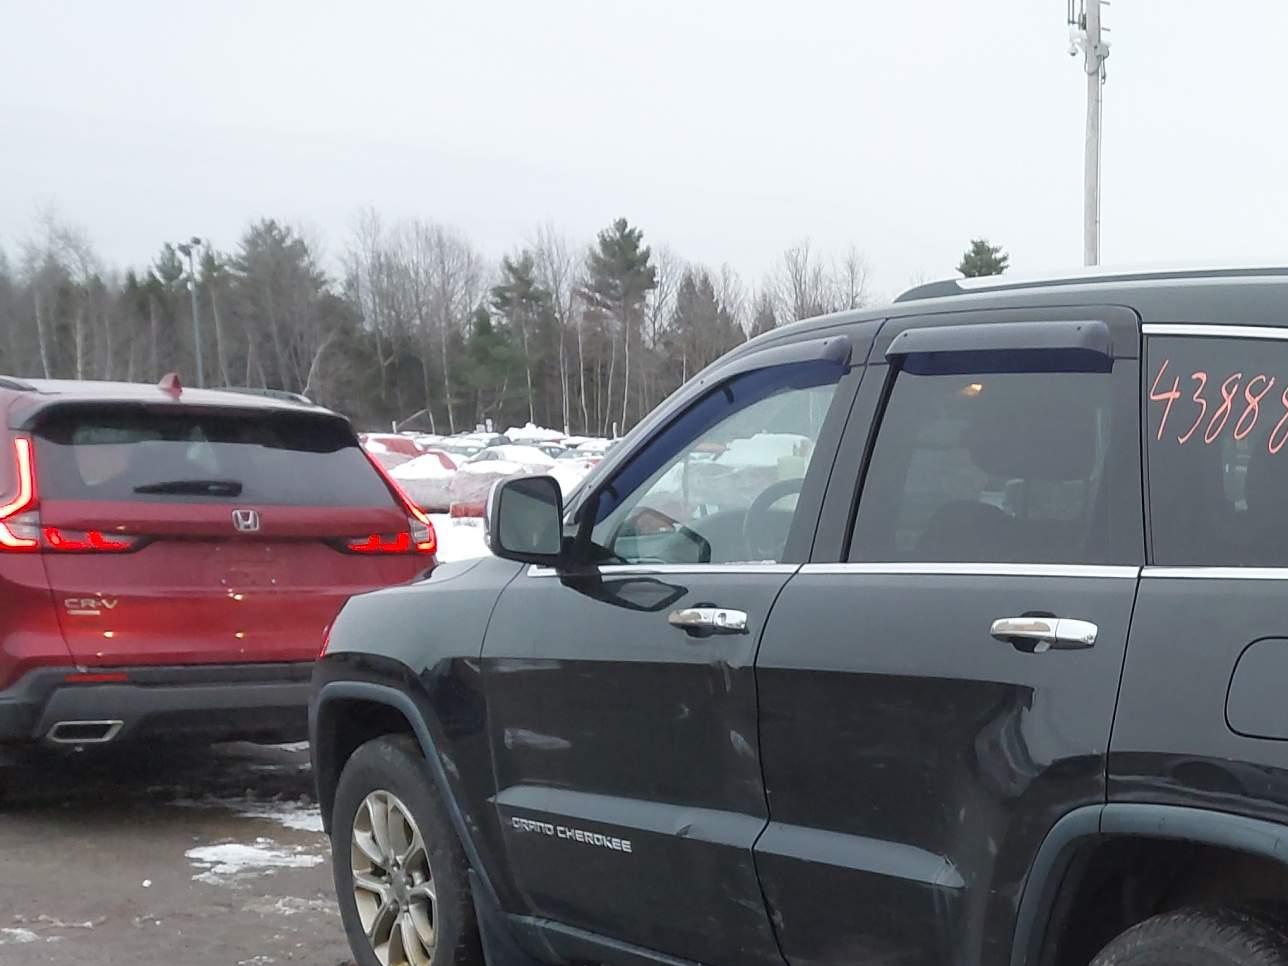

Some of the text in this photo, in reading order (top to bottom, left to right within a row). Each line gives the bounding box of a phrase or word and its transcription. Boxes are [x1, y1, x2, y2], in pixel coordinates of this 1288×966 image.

[64, 598, 118, 609] CR-V
[511, 816, 633, 853] GRAND CHEROKEE
